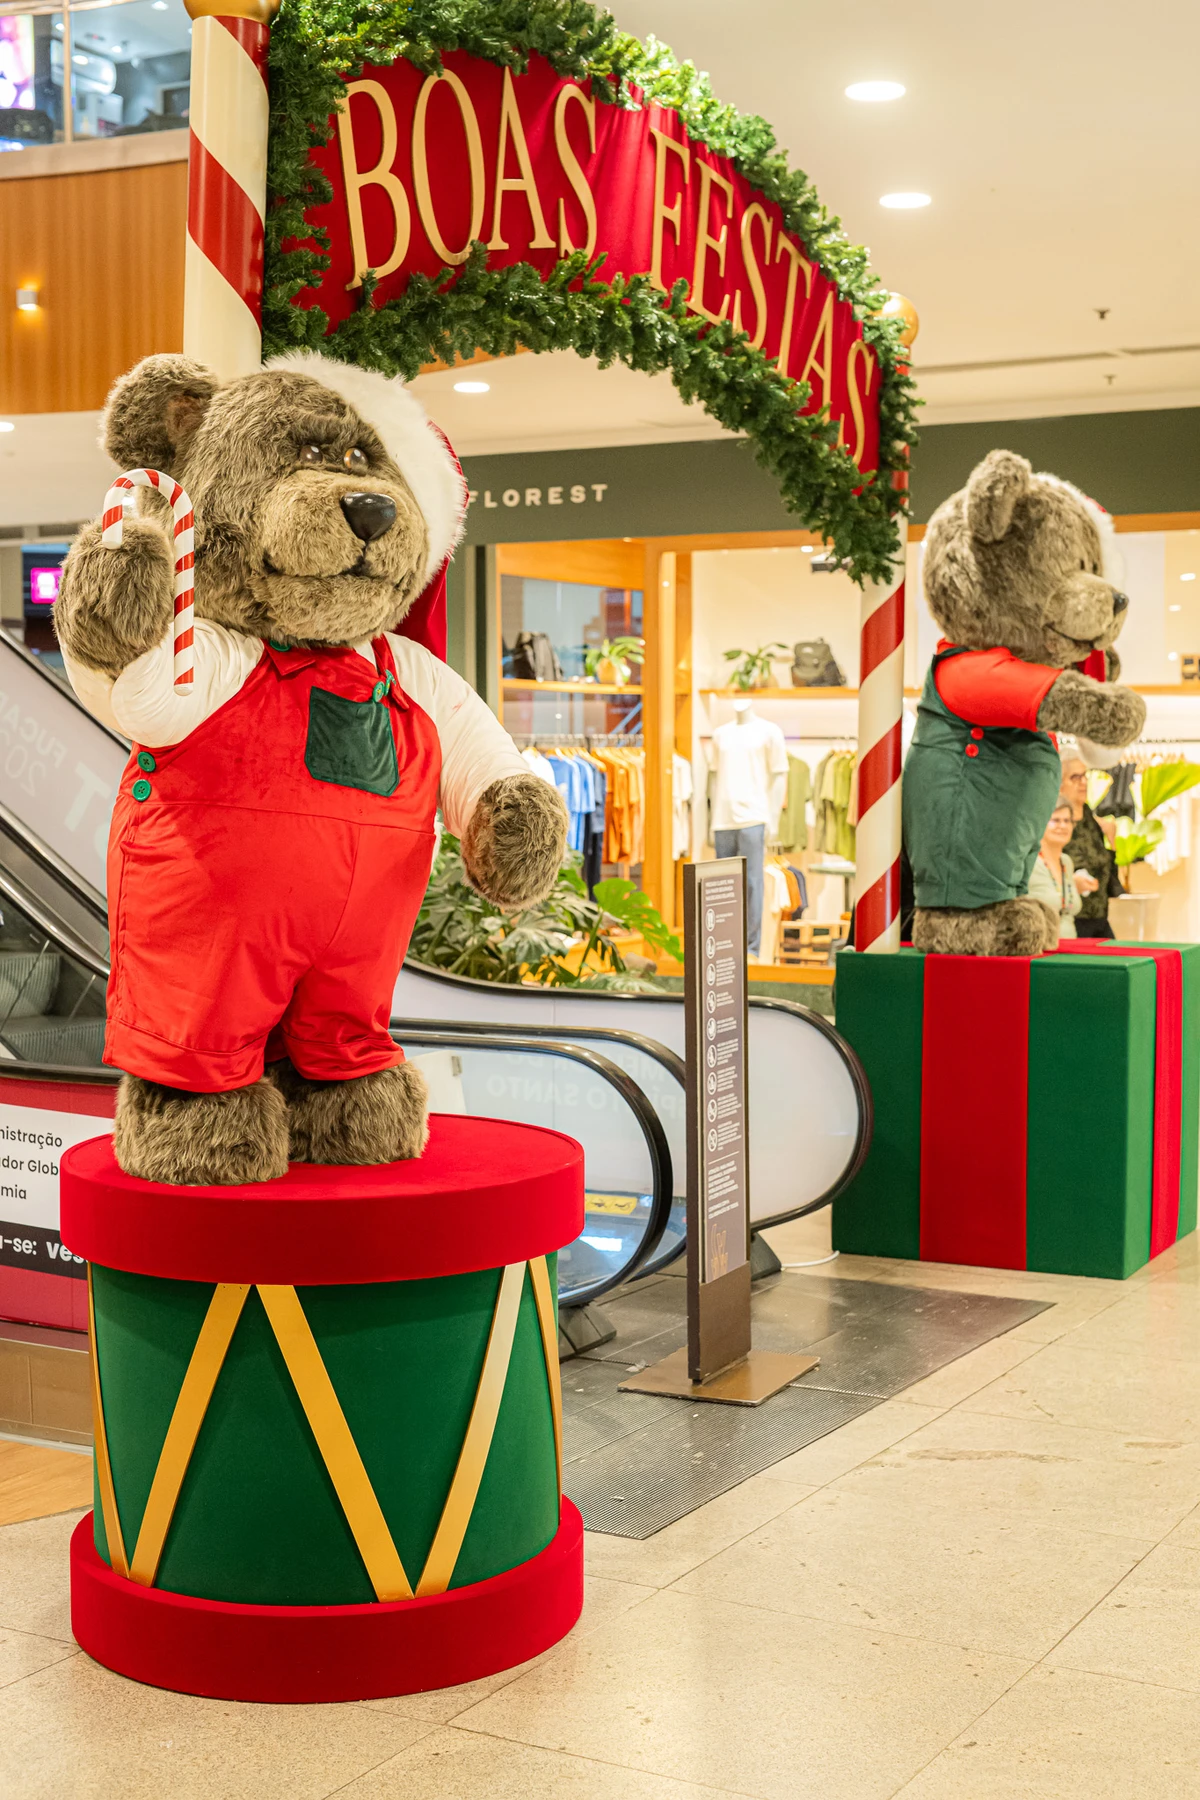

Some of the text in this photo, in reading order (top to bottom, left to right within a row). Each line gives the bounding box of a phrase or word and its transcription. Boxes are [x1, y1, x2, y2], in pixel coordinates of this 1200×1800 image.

[334, 65, 874, 466] BOAS FESTAS
[0, 1155, 59, 1176] dor Glob
[1, 1184, 27, 1200] mia
